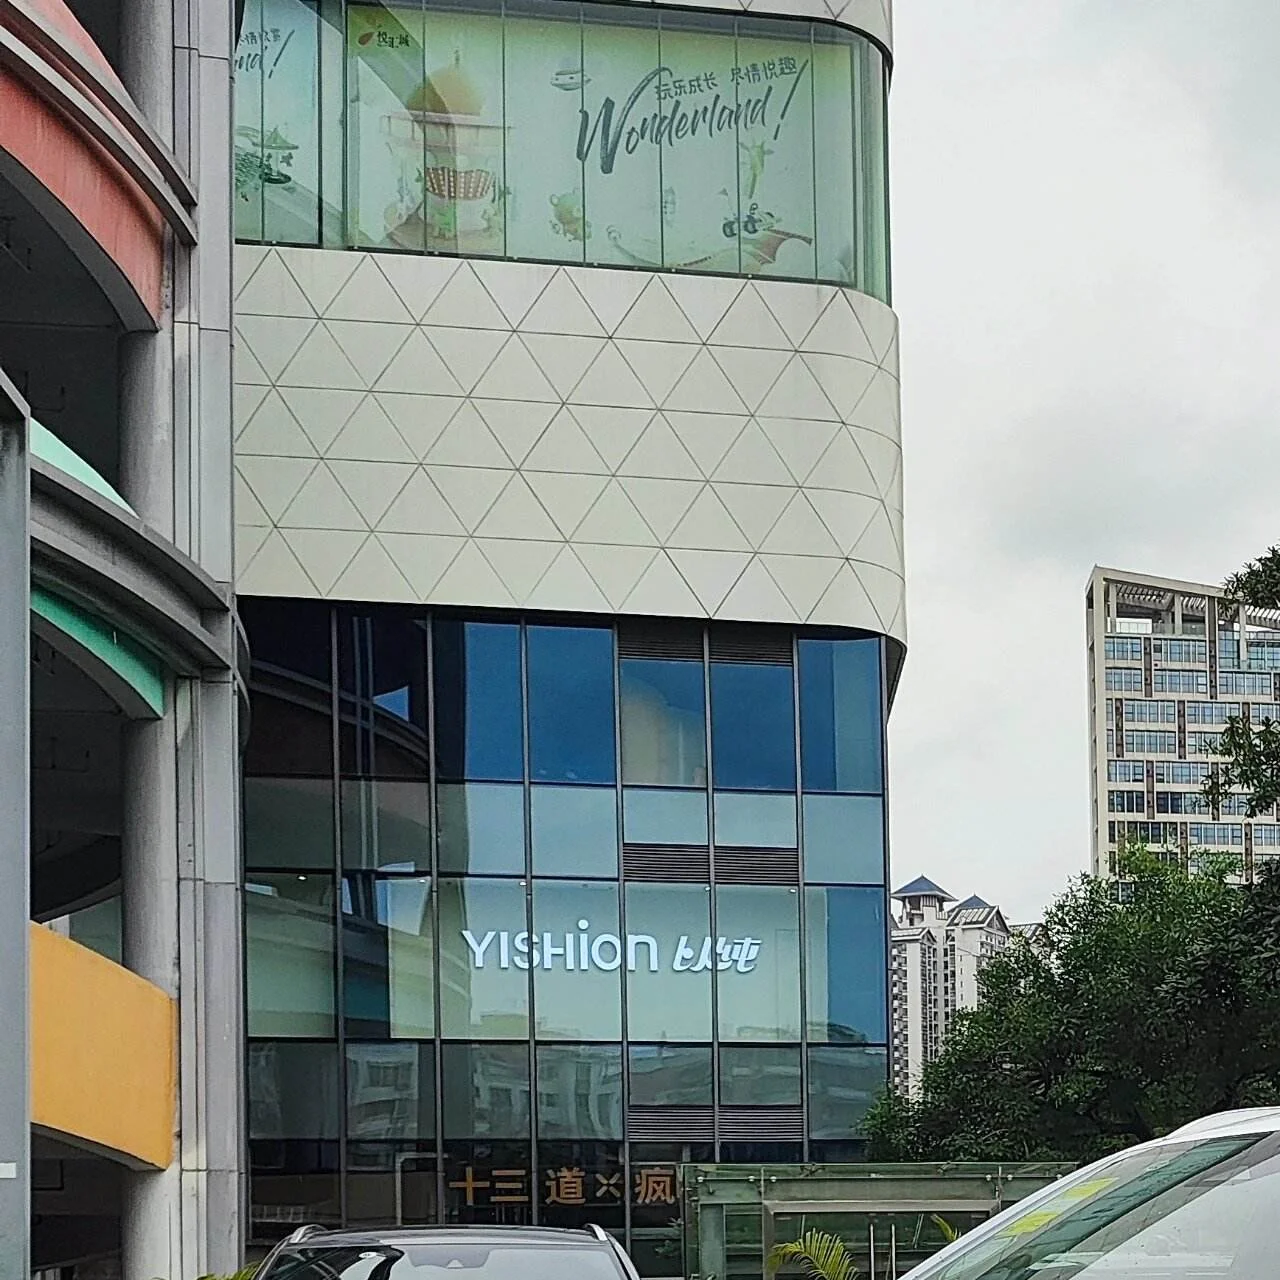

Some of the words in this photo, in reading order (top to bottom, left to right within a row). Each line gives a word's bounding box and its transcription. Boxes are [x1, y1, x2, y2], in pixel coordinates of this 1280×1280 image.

[654, 72, 719, 101] 玩乐成长
[730, 56, 797, 85] 尽情悦趣
